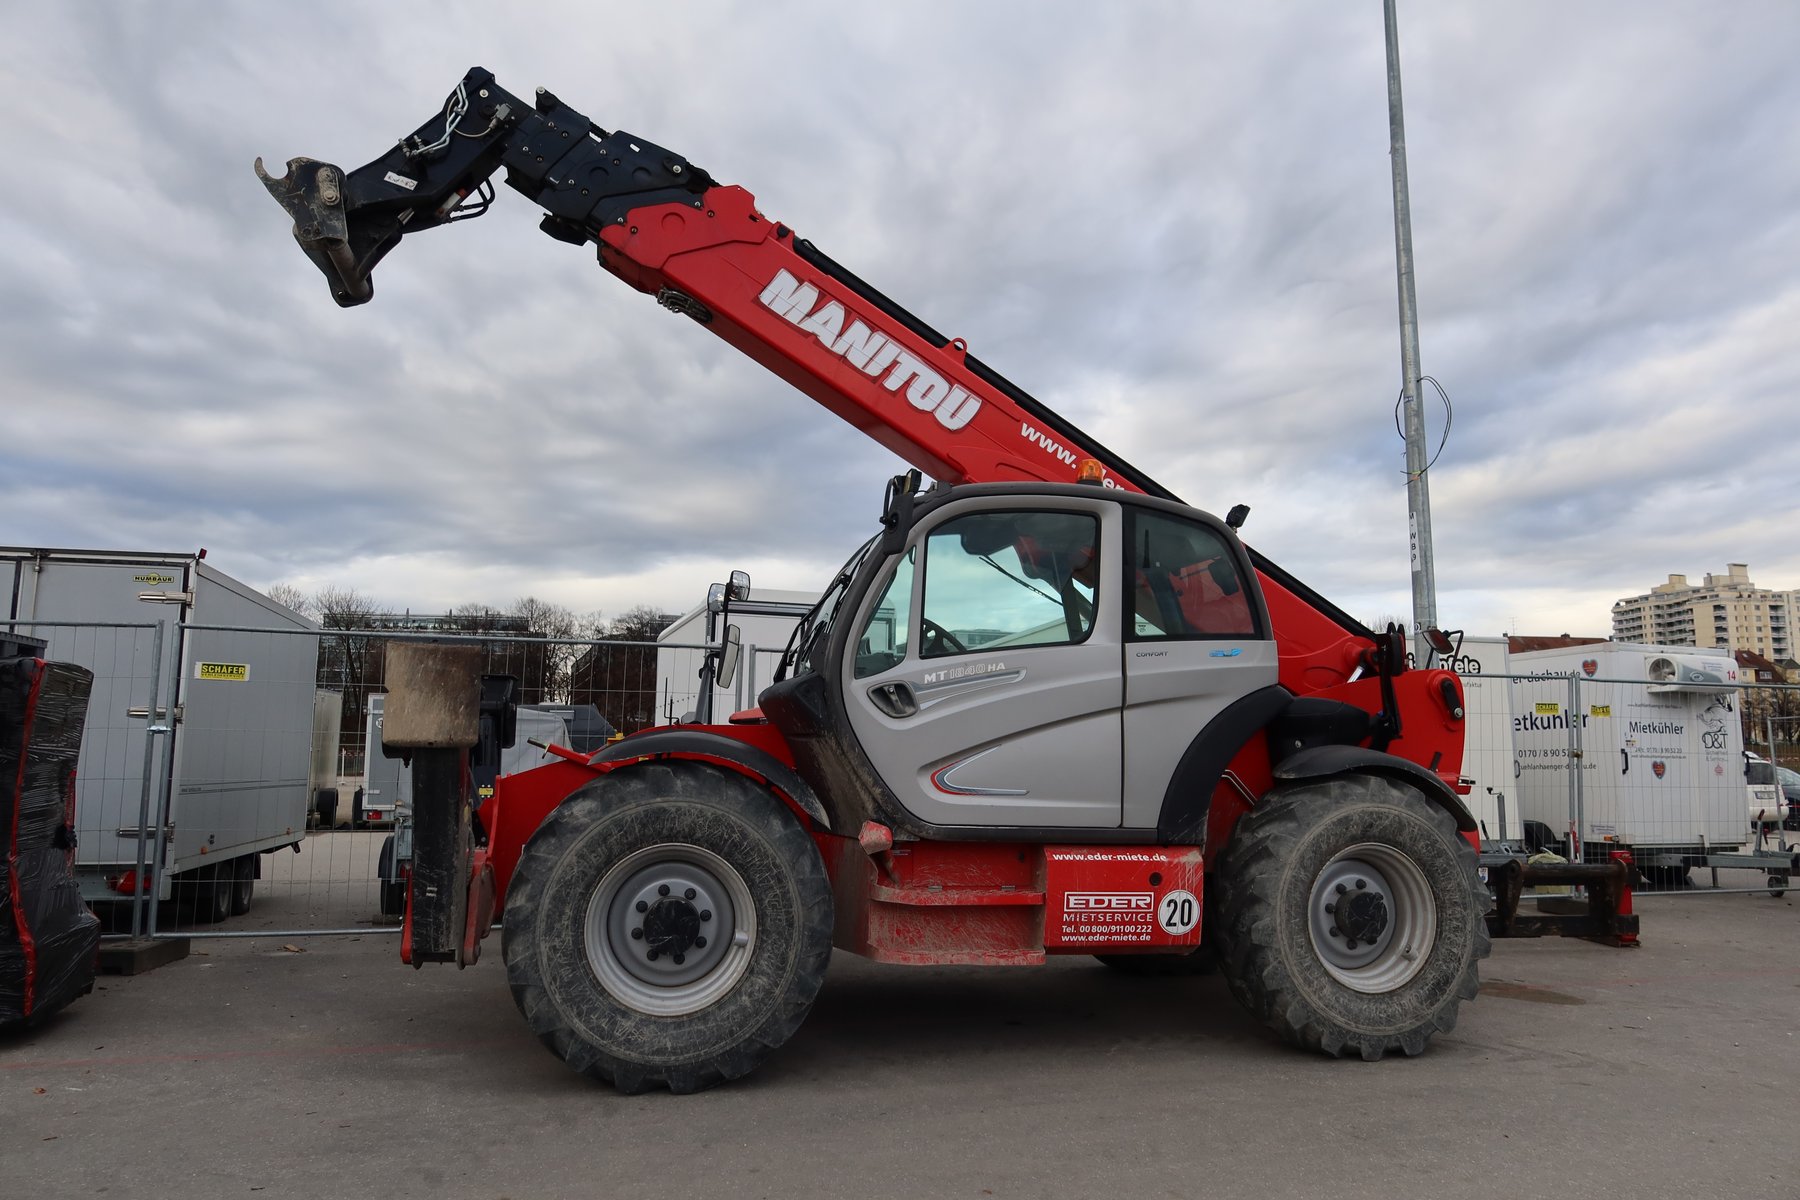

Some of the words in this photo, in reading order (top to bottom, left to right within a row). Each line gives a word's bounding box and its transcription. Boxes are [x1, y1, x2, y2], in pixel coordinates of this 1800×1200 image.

[758, 268, 983, 431] MANITOU
[1136, 650, 1169, 658] COMFORT
[201, 664, 246, 675] SCHÄFER
[924, 670, 948, 684] MT
[949, 664, 986, 679] 1840
[987, 662, 1006, 673] HA
[1727, 670, 1736, 681] 14
[1629, 720, 1684, 735] Mietkühler
[1702, 731, 1729, 749] D&T
[1518, 749, 1537, 758] 0170
[1543, 749, 1549, 757] 8
[1550, 749, 1560, 757] 90
[1052, 853, 1168, 862] www.eder-miete.de
[1068, 895, 1152, 909] EDER
[1063, 913, 1154, 922] MIETSERVICE
[1165, 898, 1192, 927] 20
[1062, 925, 1077, 933] Tel.
[1061, 934, 1152, 942] www.eder-miete.de
